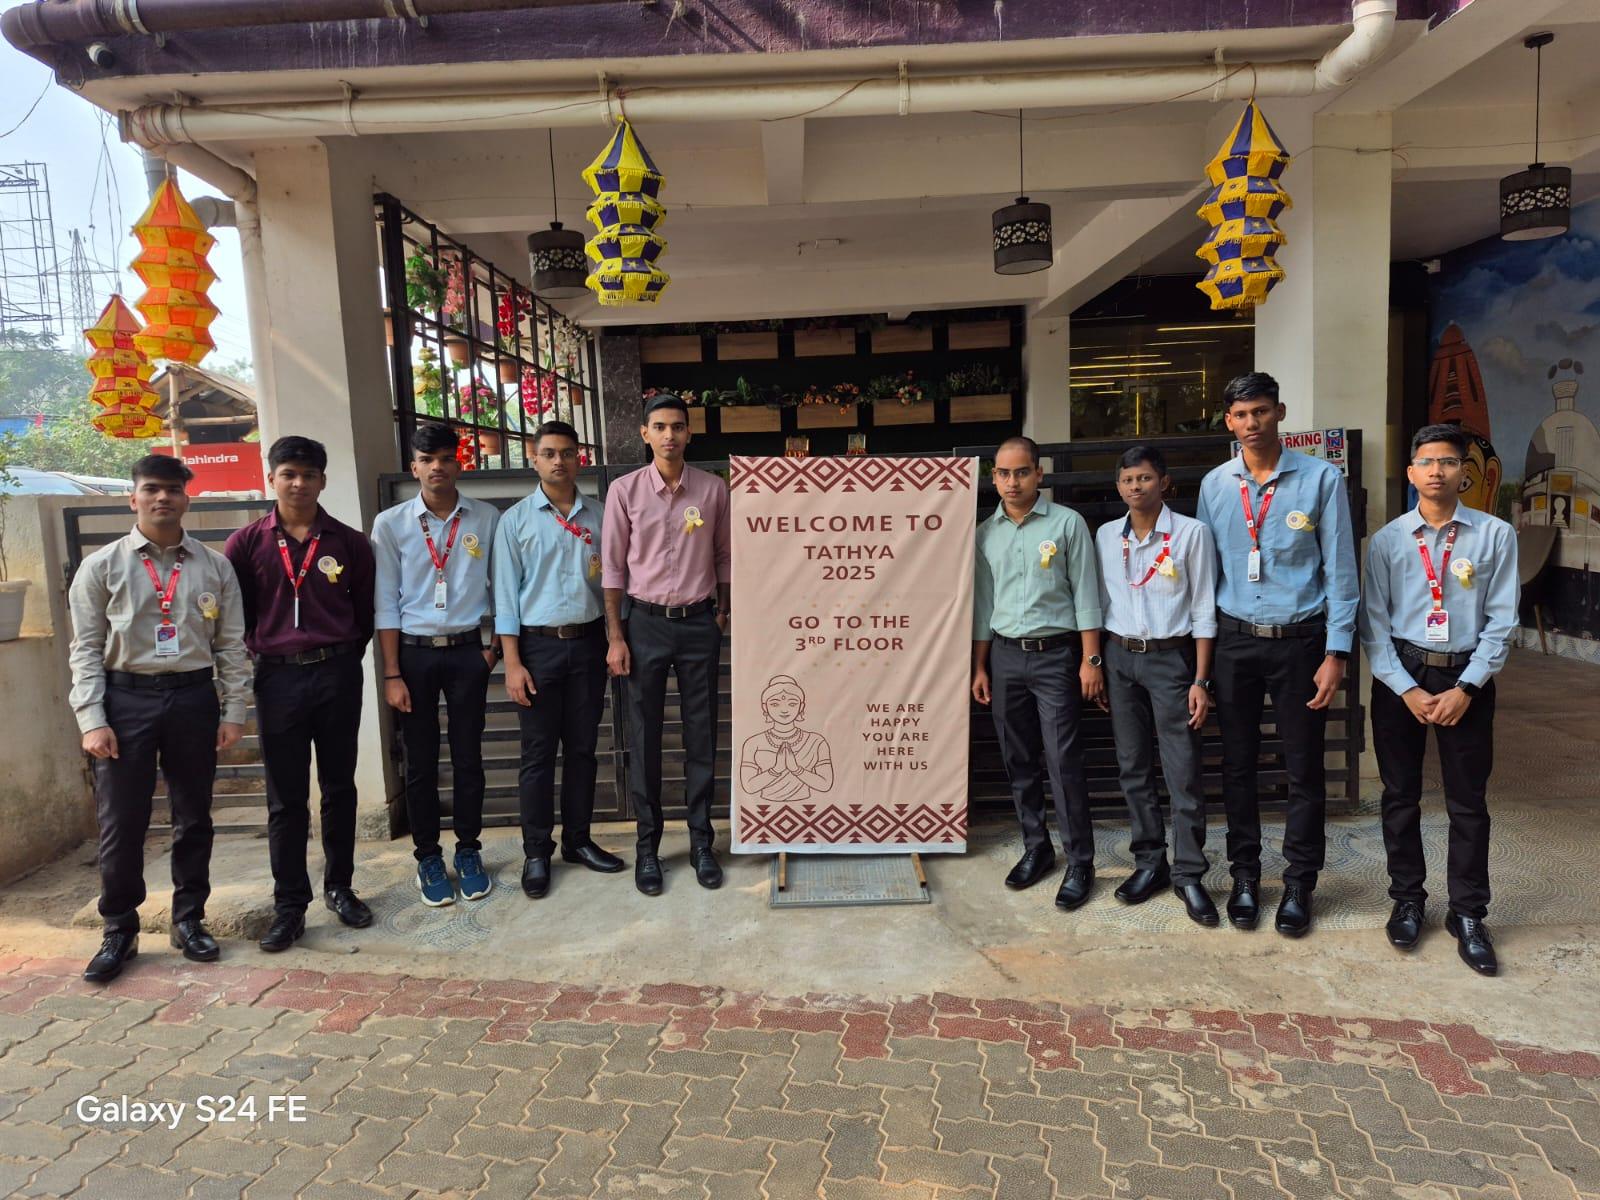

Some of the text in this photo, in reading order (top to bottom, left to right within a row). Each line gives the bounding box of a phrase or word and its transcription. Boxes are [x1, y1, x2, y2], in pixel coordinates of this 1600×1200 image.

[1279, 432, 1322, 448] RKING
[746, 514, 943, 533] WELCOME TO
[803, 544, 895, 560] TATHYA
[822, 565, 876, 581] 2025
[788, 615, 910, 630] GO TO THE
[795, 636, 904, 651] 3RD FLOOR
[867, 703, 925, 713] WE ARE
[871, 718, 920, 727] HAPPY
[862, 732, 929, 742] YOU ARE
[877, 747, 914, 756] HERE
[863, 761, 928, 770] WITH US
